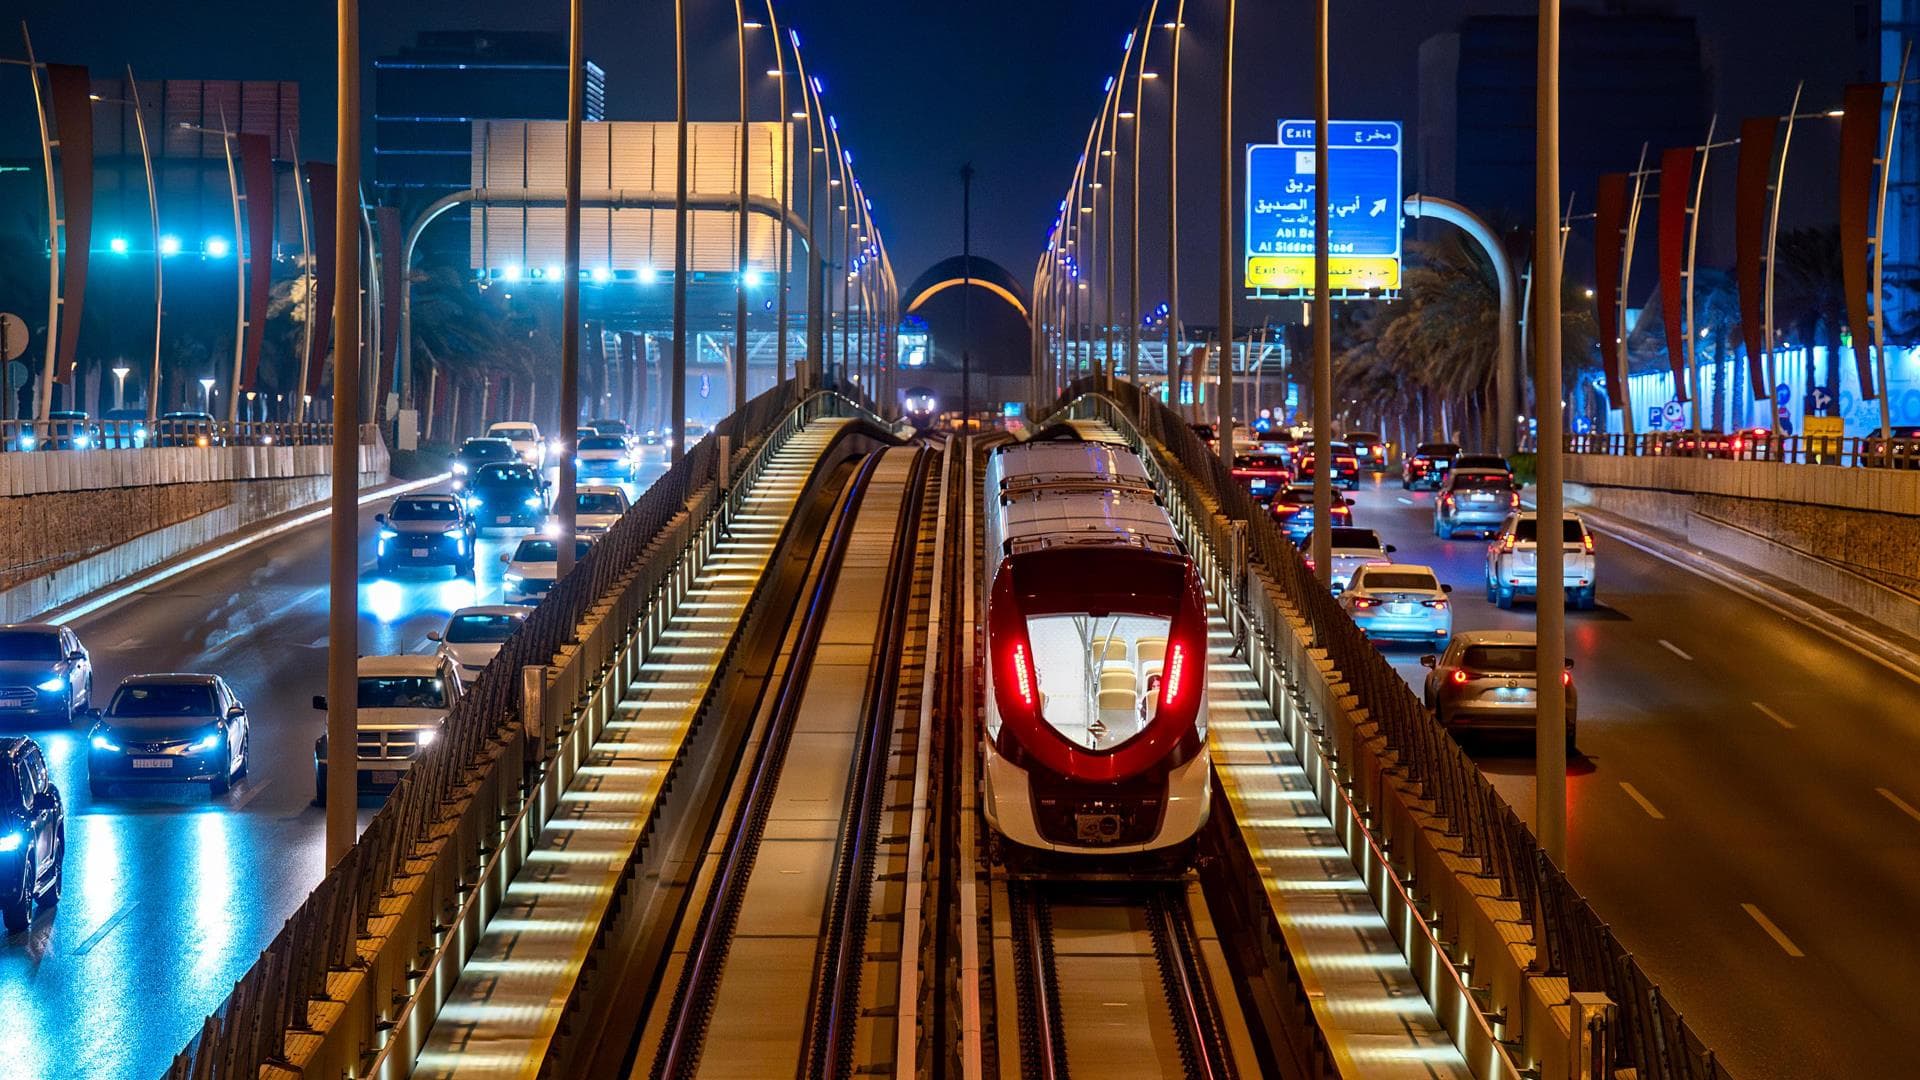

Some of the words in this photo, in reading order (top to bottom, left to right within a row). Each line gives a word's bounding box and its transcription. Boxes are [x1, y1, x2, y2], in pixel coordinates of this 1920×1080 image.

[1286, 128, 1312, 138] Exit
[1355, 129, 1392, 143] مخرج
[1255, 198, 1307, 216] الصديق
[1276, 228, 1296, 238] Abi
[1258, 242, 1272, 252] Al
[1275, 242, 1316, 252] Siddee
[1255, 265, 1276, 275] Exit
